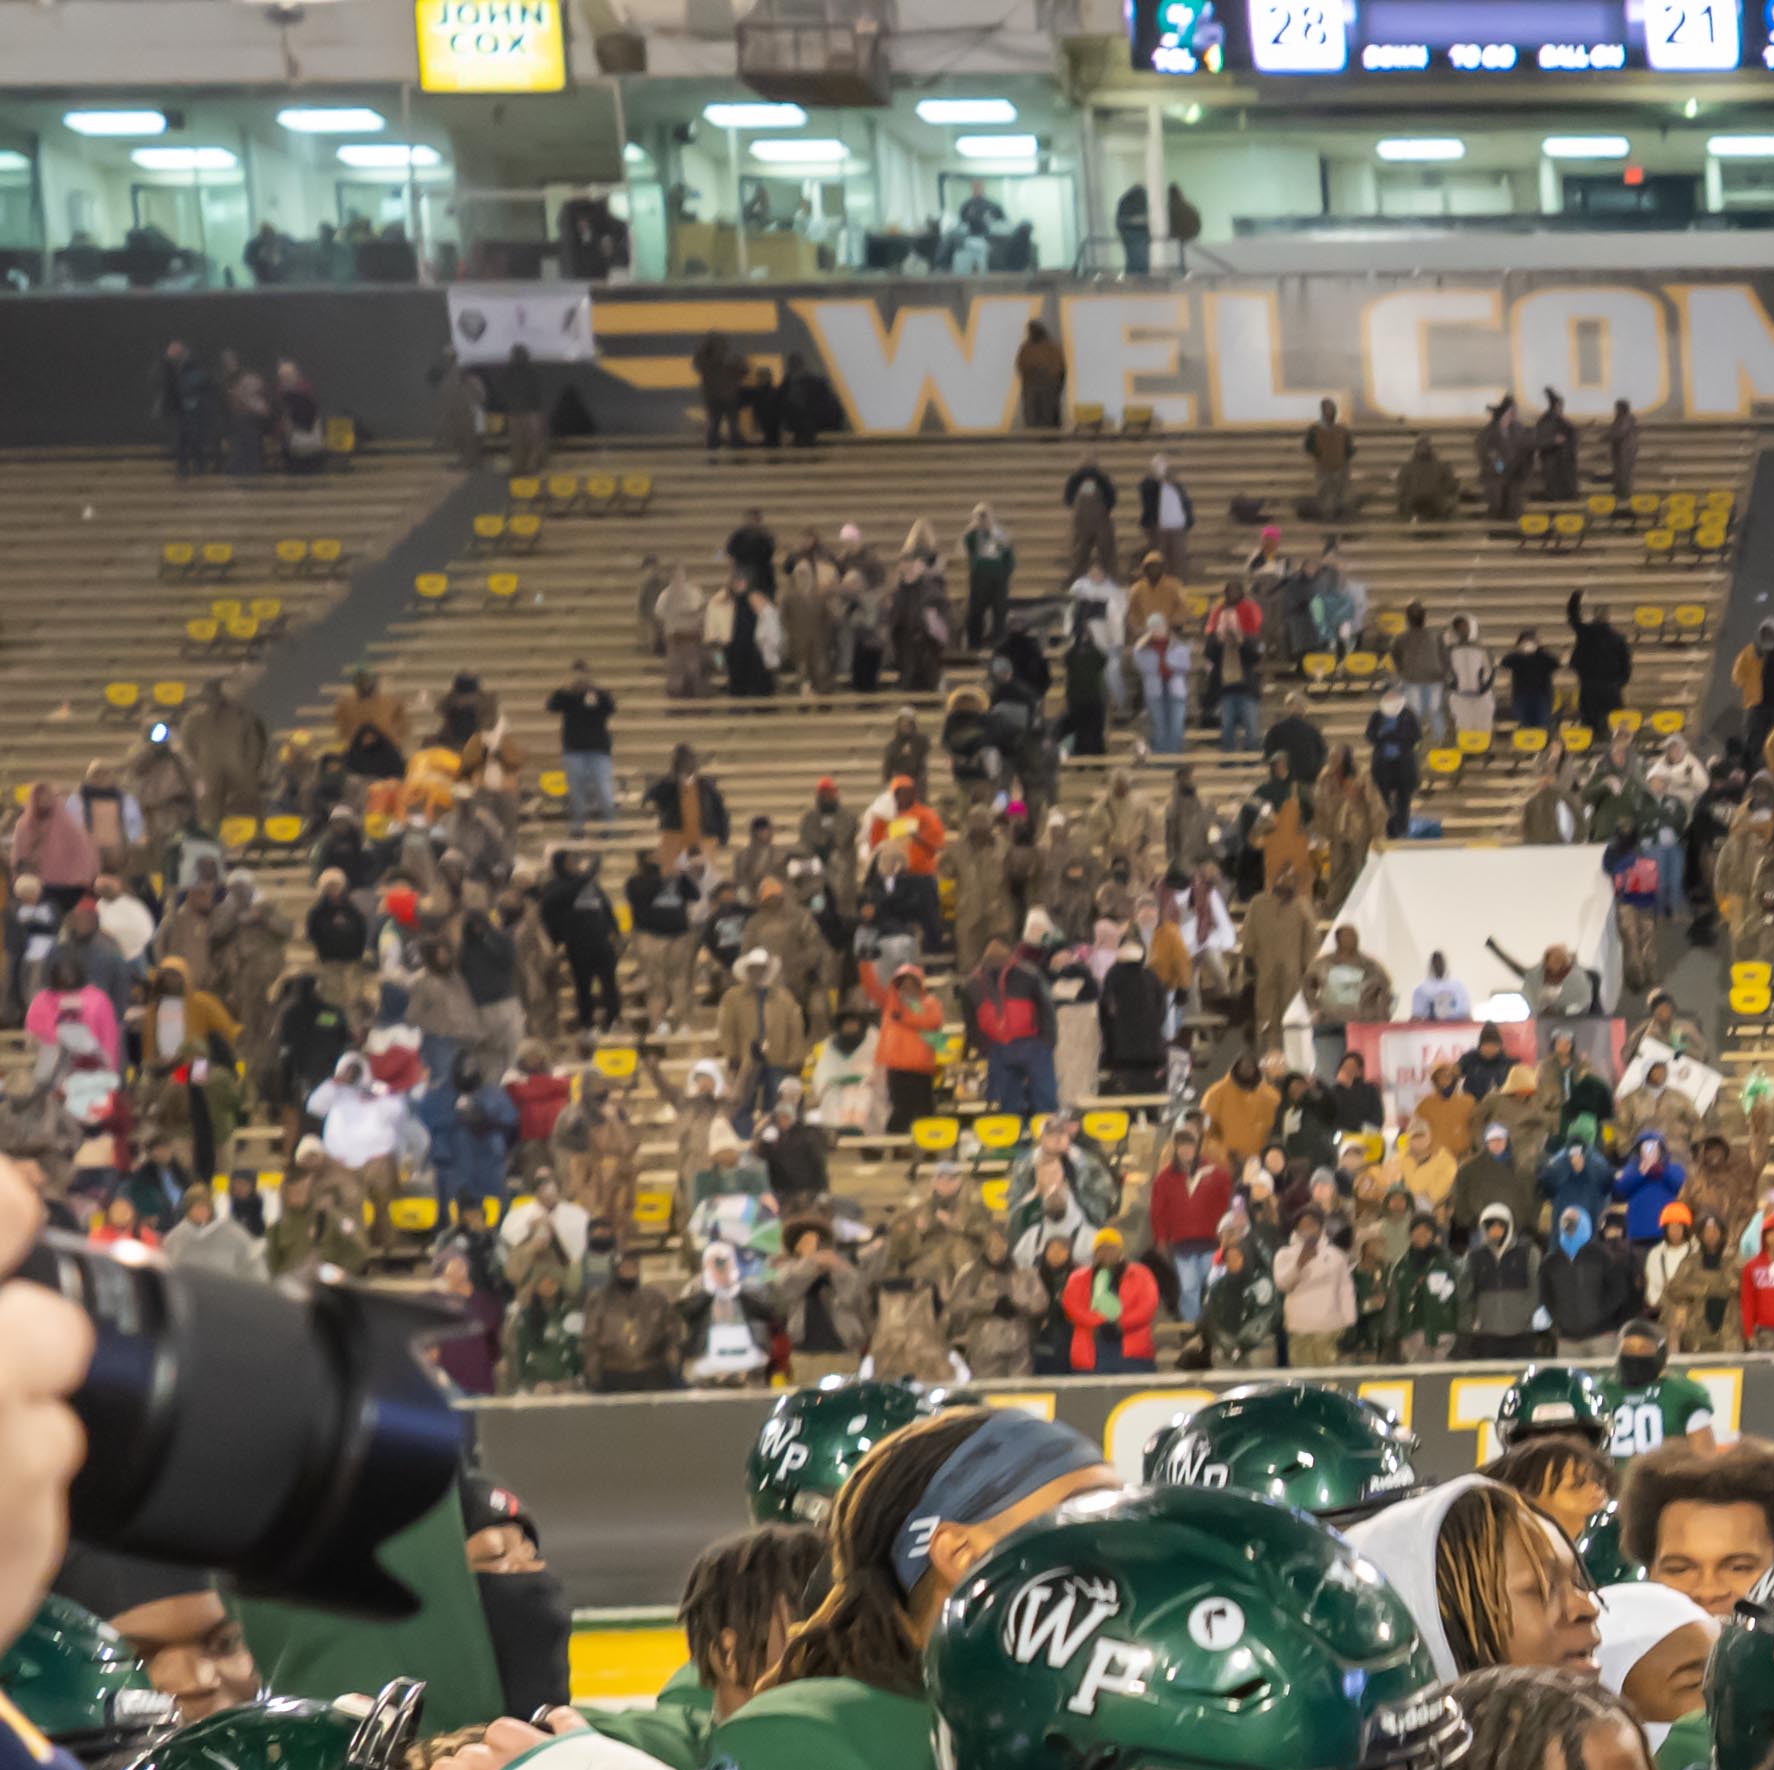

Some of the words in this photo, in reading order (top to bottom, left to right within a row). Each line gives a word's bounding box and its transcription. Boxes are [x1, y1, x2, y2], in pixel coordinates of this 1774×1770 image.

[438, 1, 543, 24] JOHN
[1268, 4, 1329, 46] 28
[1664, 4, 1716, 45] 21
[450, 32, 526, 53] COX
[1610, 1403, 1664, 1456] 20
[1006, 1574, 1153, 1715] WP
